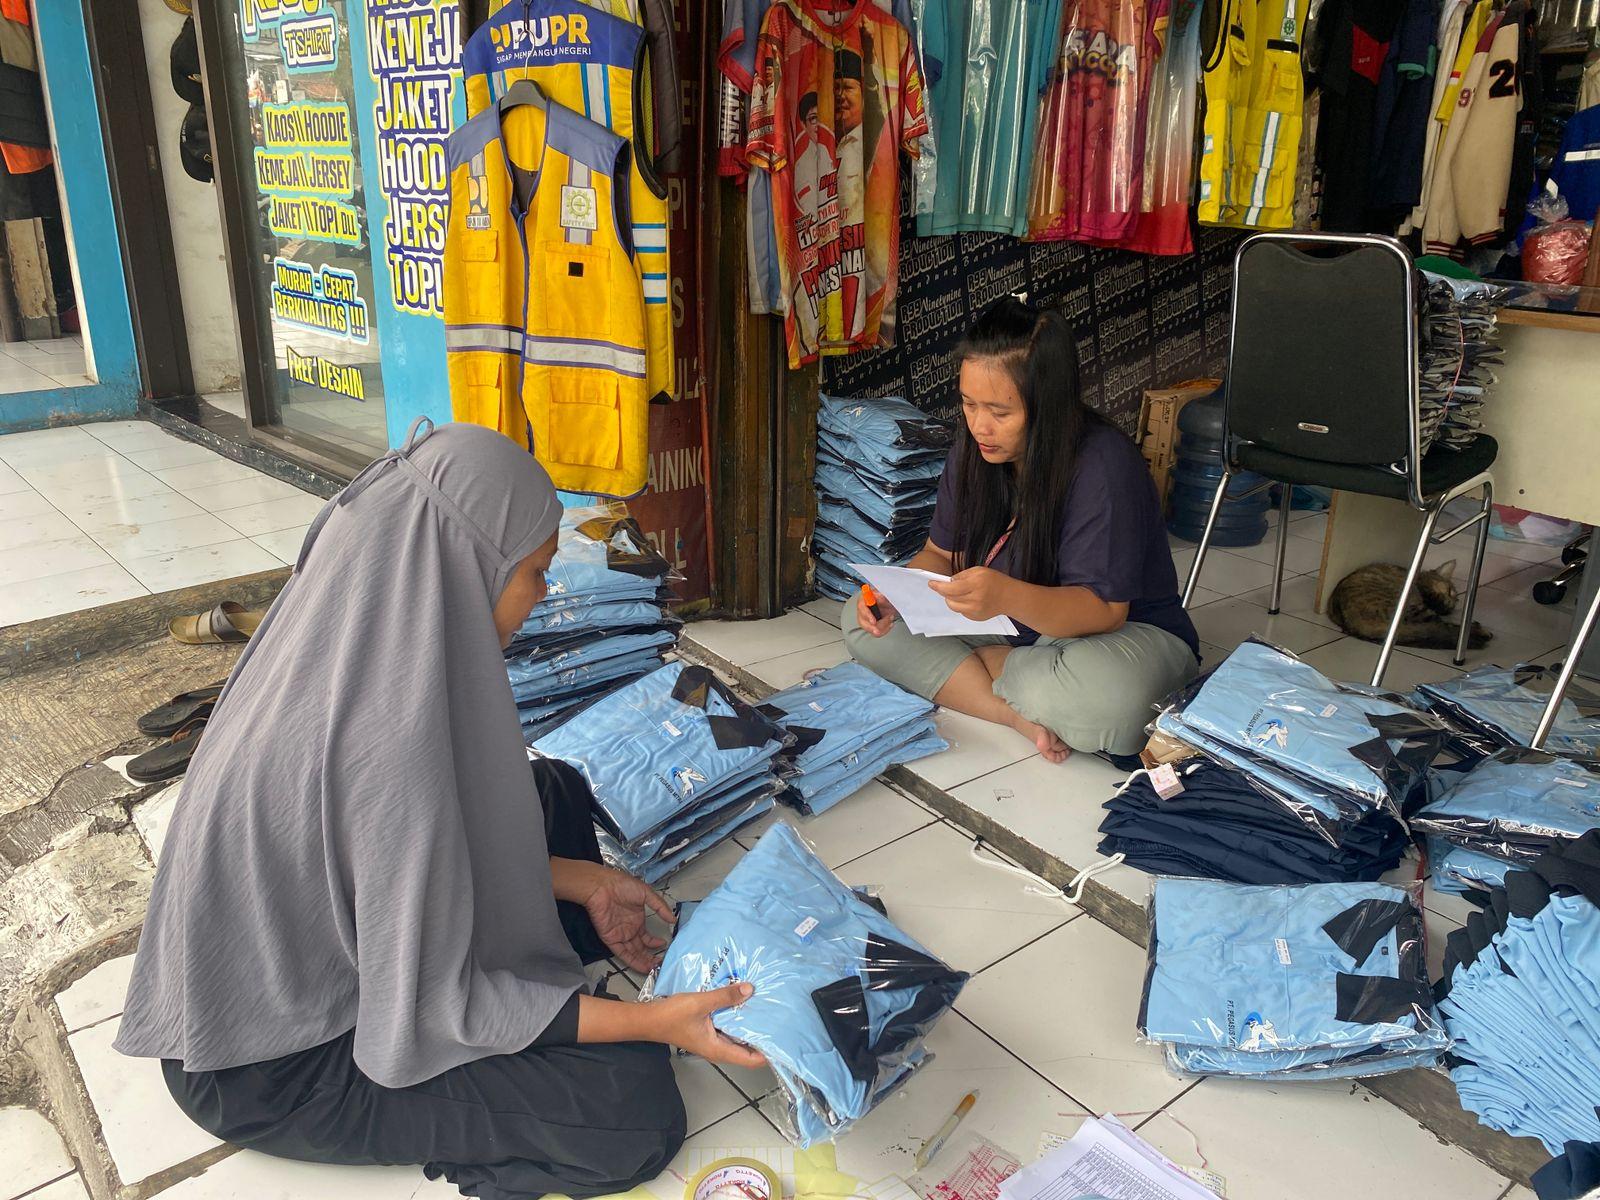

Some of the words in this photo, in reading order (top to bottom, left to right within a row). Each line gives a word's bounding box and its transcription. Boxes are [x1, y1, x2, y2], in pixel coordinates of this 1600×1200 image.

[510, 13, 591, 50] PUPR
[558, 46, 591, 55] NEGERI
[379, 76, 449, 130] JAKET
[266, 111, 293, 143] KAOS
[304, 109, 348, 142] HOODIE
[257, 155, 298, 187] KEMEJA
[309, 156, 350, 190] JERSEY
[271, 198, 302, 230] JAKET
[311, 201, 339, 234] TOPI
[341, 206, 357, 236] DLL
[277, 264, 312, 293] MURAH
[323, 269, 354, 301] CEPAT
[274, 290, 347, 333] BERKUALITAS
[287, 344, 316, 385] FREE
[316, 357, 365, 401] DESAIN
